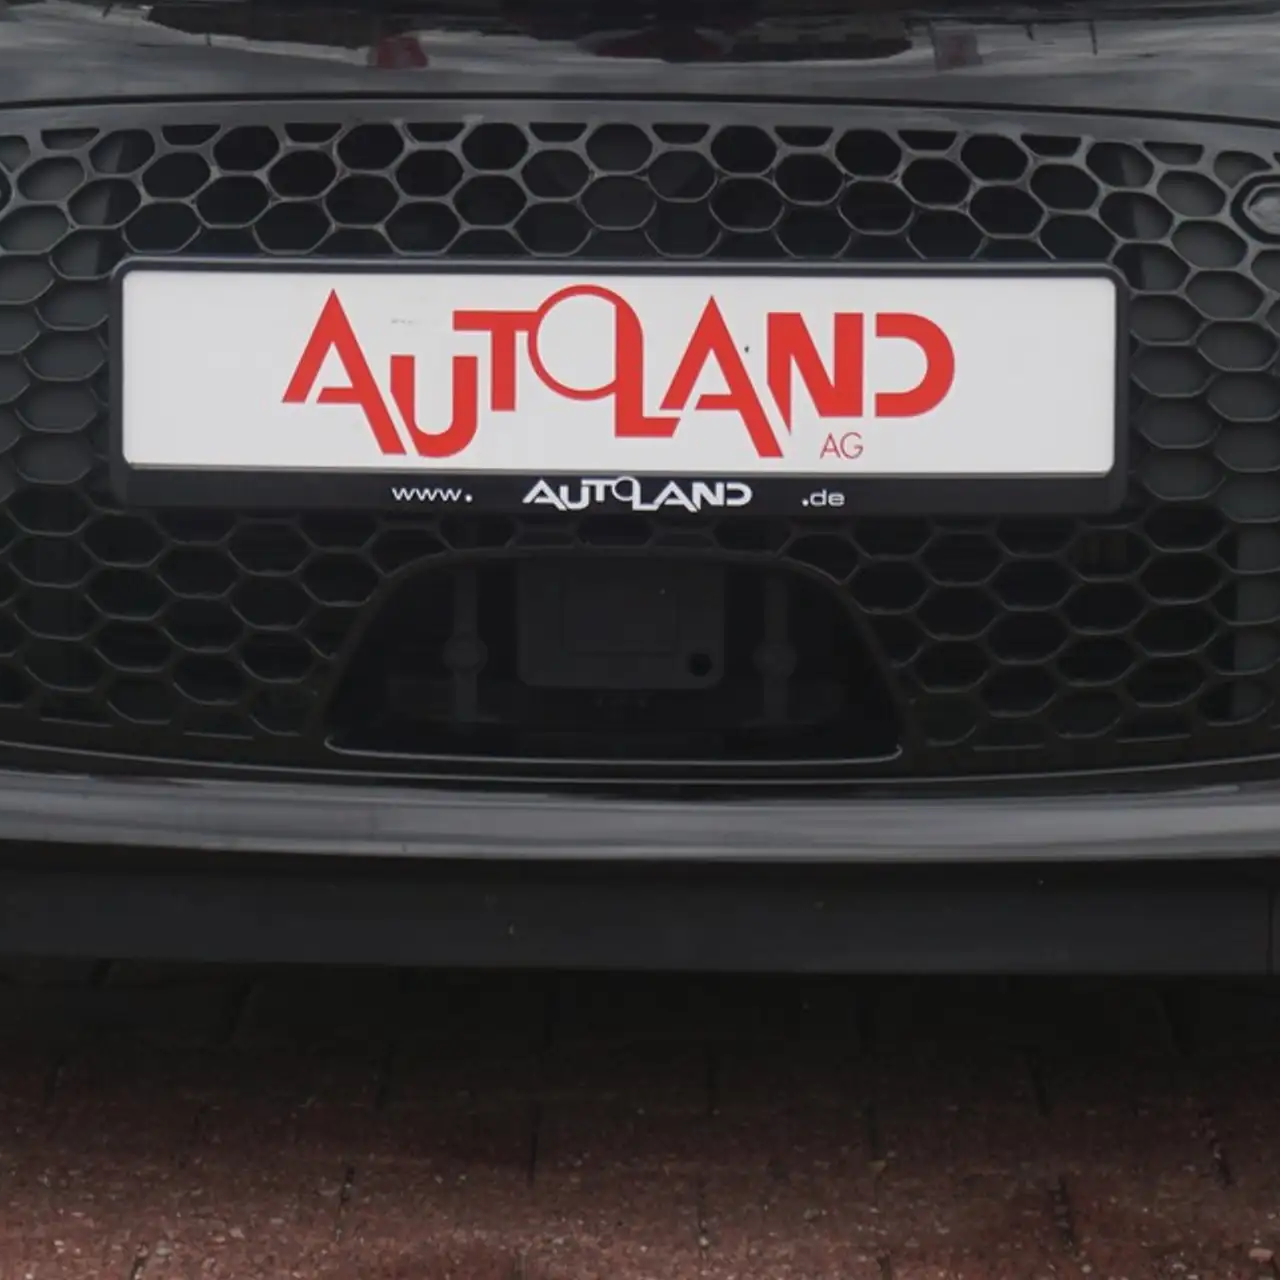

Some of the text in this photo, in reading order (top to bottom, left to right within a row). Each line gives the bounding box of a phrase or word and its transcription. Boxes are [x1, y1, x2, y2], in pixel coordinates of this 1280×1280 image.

[281, 284, 955, 459] AUTOLAND
[819, 433, 863, 460] AG
[522, 476, 753, 513] AUTOLAND
[801, 490, 846, 507] .de
